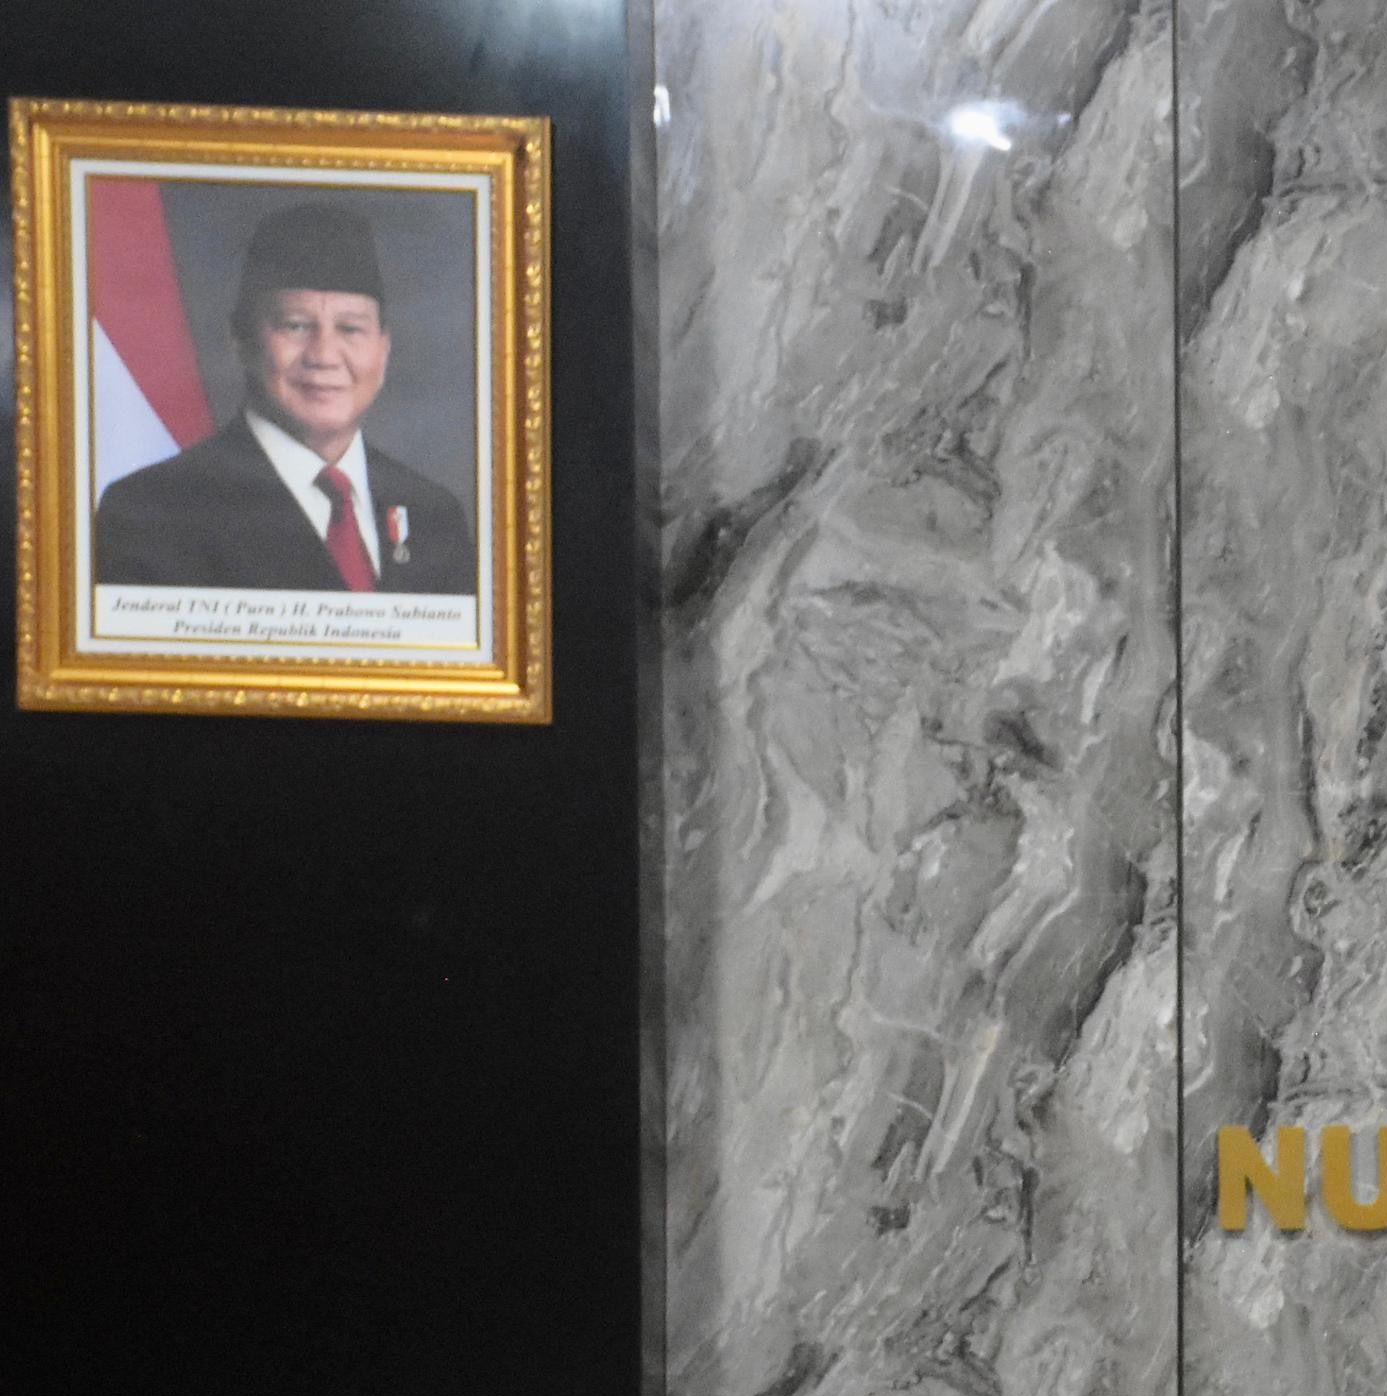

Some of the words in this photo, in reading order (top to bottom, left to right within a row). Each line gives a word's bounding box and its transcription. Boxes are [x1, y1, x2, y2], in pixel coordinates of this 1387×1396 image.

[112, 597, 181, 613] Jenderal
[188, 600, 220, 614] TNI
[236, 600, 275, 615] Purn
[316, 603, 386, 618] Prabowo
[392, 605, 462, 621] Subianto
[174, 620, 242, 634] Presiden
[249, 622, 318, 640] Republik
[323, 625, 401, 639] Indonesia
